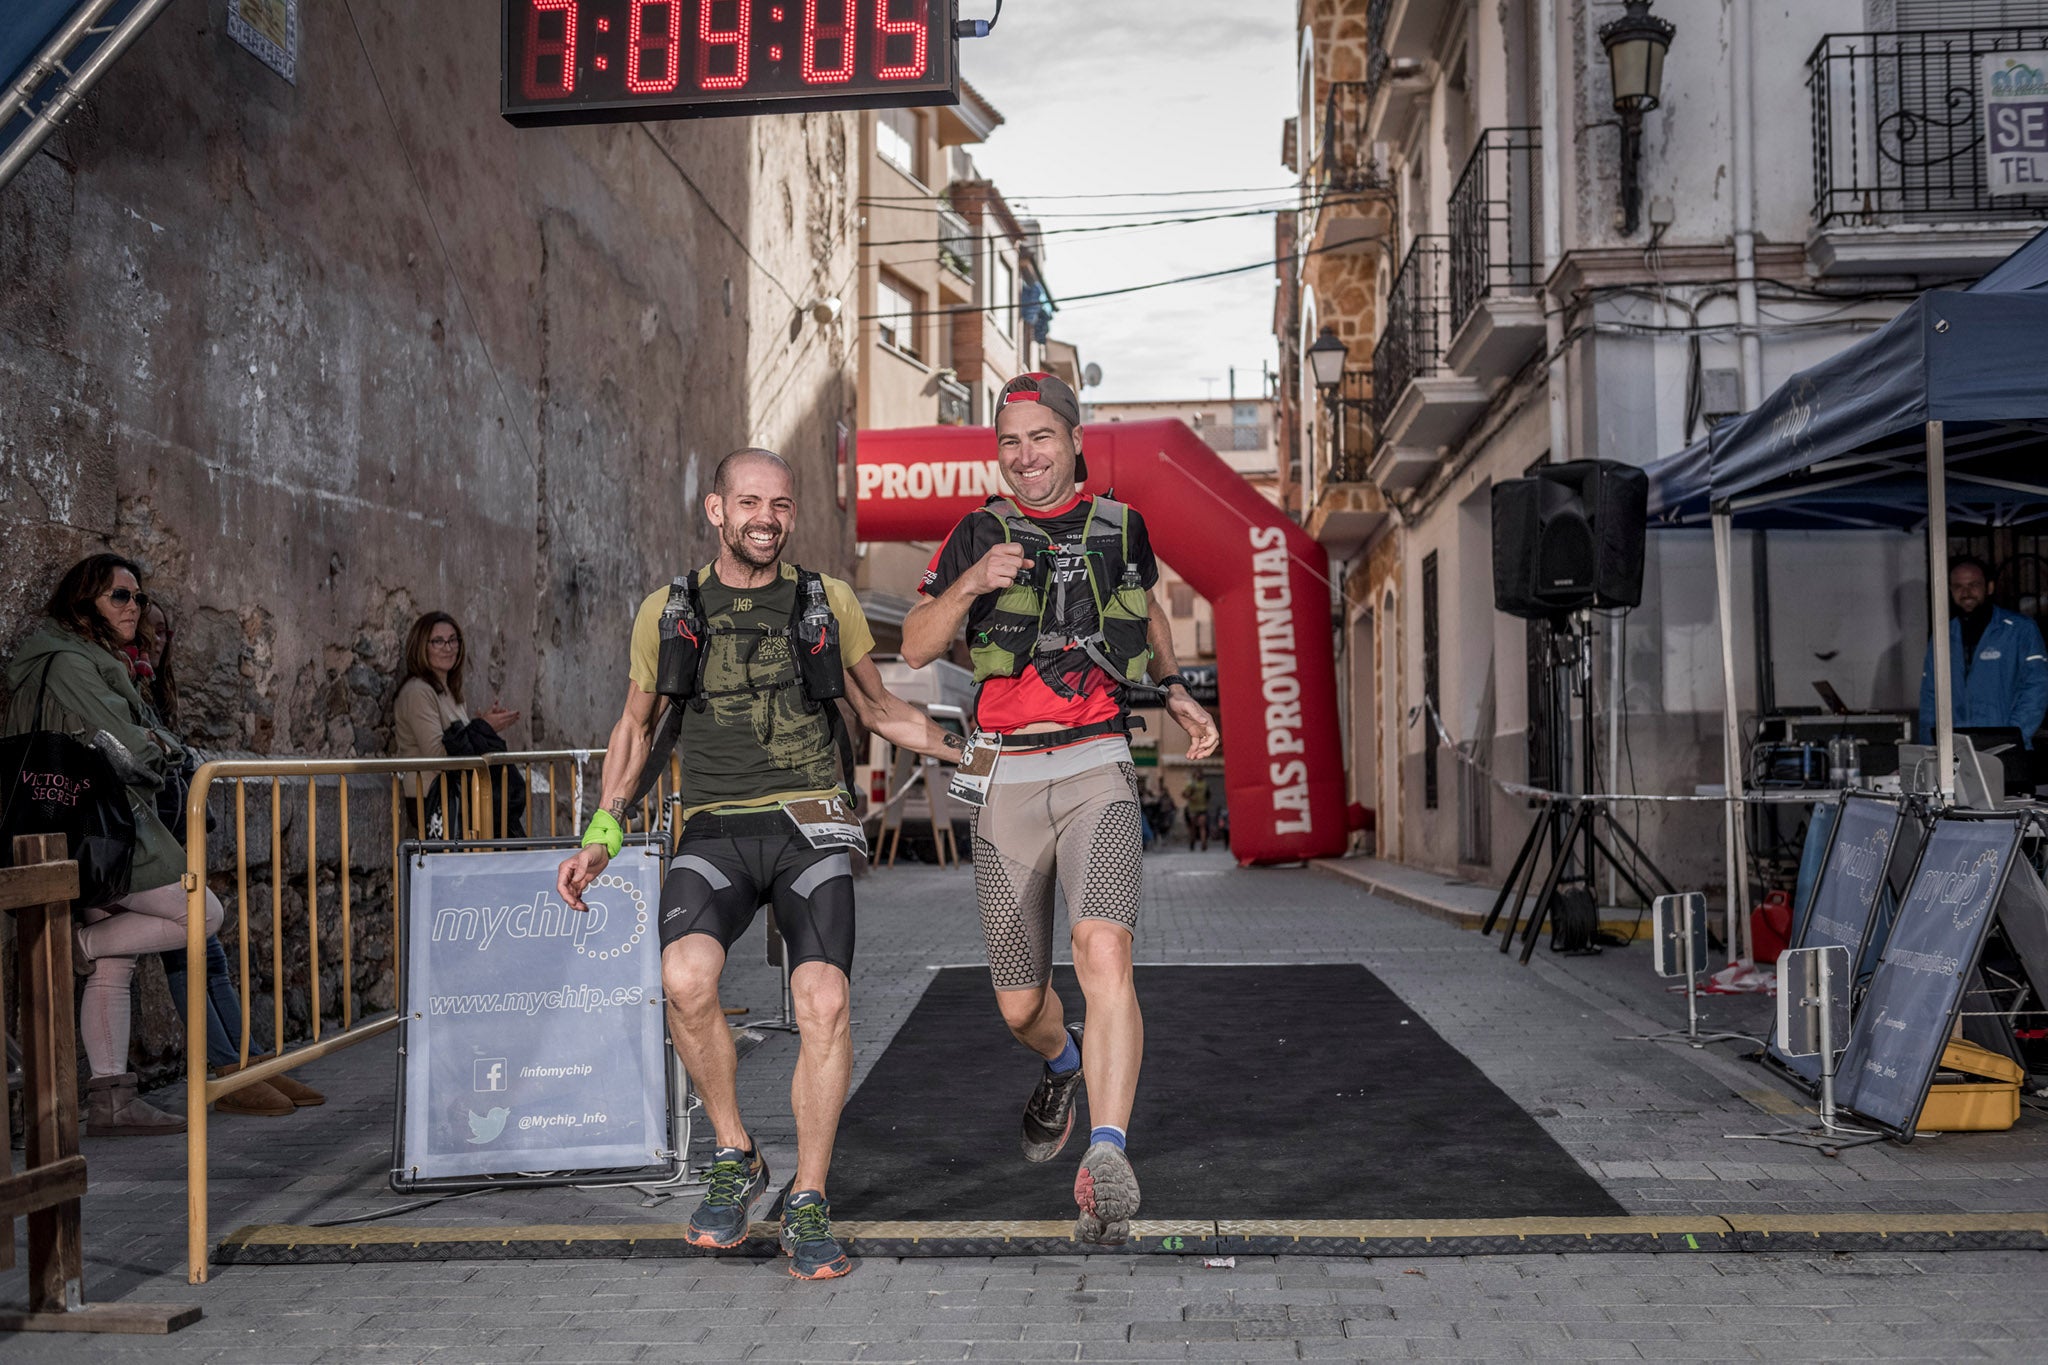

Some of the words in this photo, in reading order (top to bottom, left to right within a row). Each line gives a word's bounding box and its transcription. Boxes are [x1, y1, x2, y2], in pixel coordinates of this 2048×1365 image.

[1997, 107, 2046, 147] SE
[995, 623, 1026, 633] CAMP
[1249, 526, 1305, 757] PROVINCIAS
[22, 770, 91, 794] VICTORIA'S
[31, 787, 80, 806] SECRET
[1269, 760, 1312, 835] LAS
[431, 891, 609, 951] mychip
[429, 984, 644, 1016] www.mychip.es
[519, 1063, 593, 1078] /infomychip
[518, 1111, 607, 1130] @Mychip_Info
